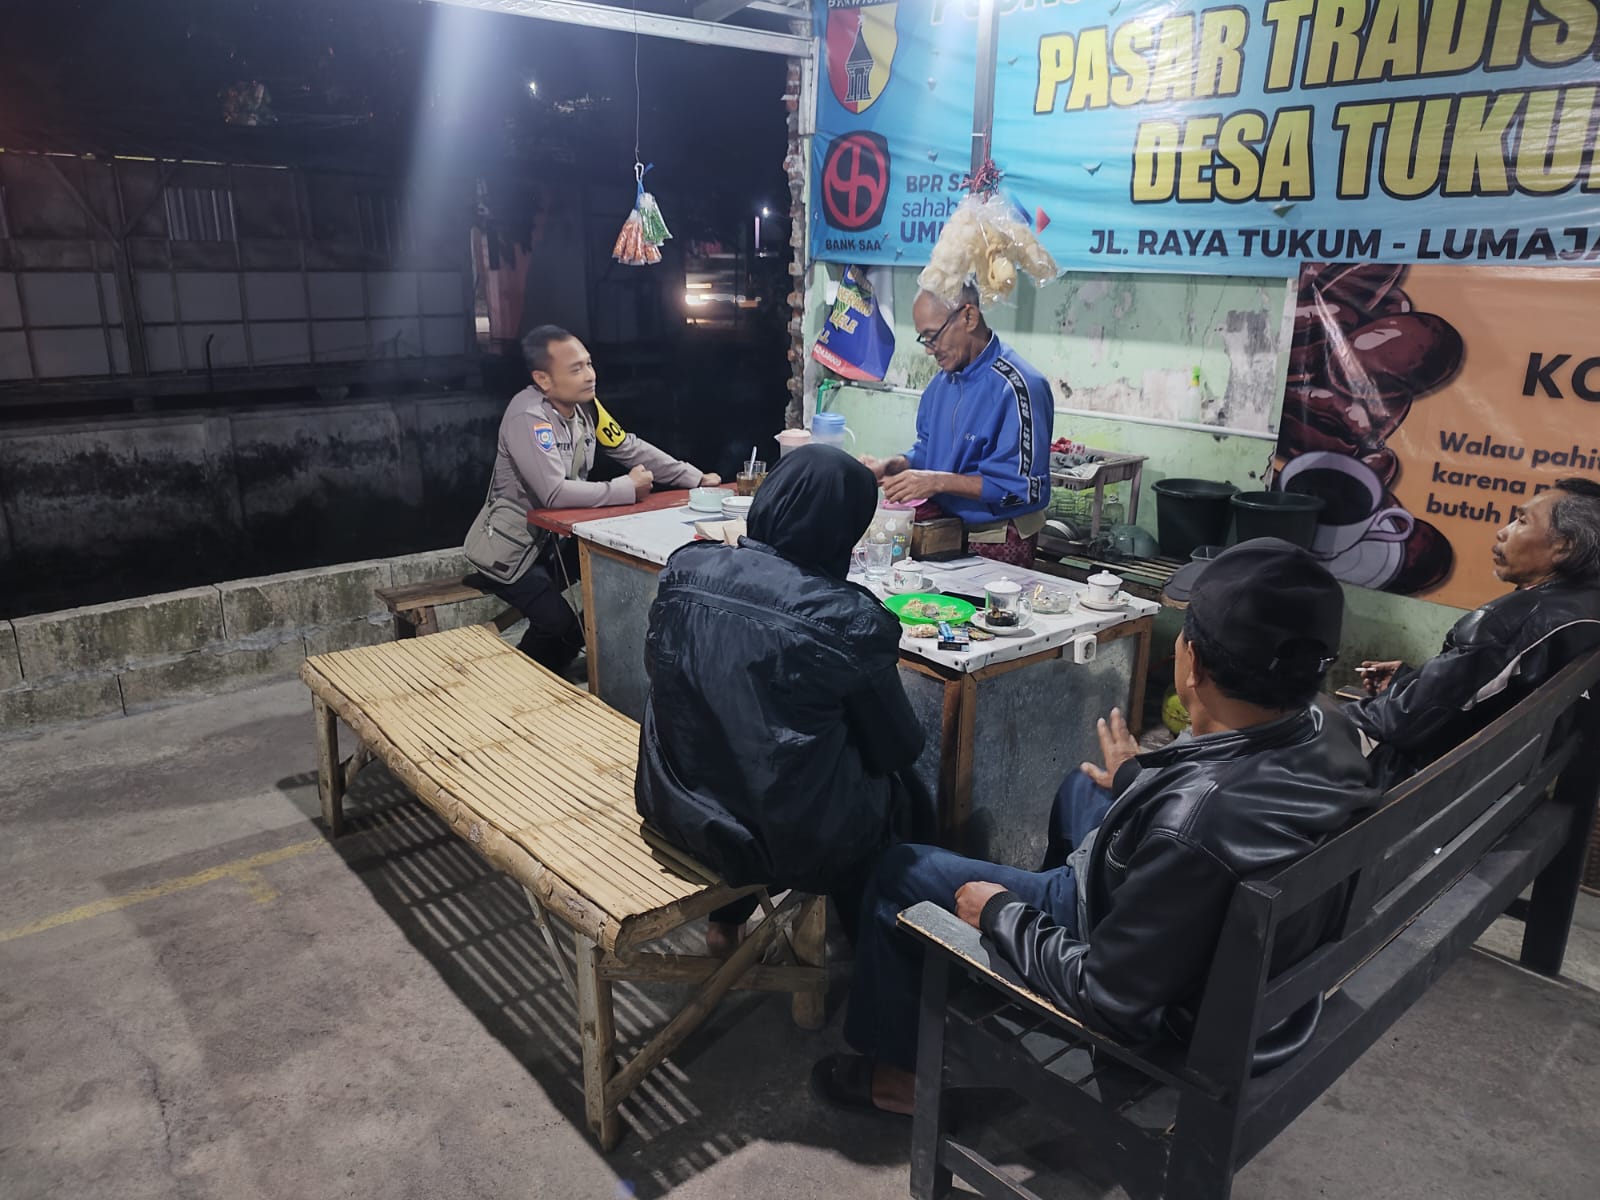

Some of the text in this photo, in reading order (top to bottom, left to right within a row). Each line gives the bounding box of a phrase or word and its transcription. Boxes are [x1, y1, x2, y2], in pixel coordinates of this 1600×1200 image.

[1034, 0, 1600, 115] PASAR TRADIS
[1130, 81, 1600, 203] DESA TUKU
[906, 174, 943, 193] BPR
[825, 239, 882, 251] BANK SAA
[1089, 229, 1128, 256] JL.
[1137, 230, 1229, 257] RAYA
[1238, 229, 1382, 258] TUKUM
[1440, 430, 1600, 471] Walau pahi
[1432, 462, 1526, 494] karena
[1426, 493, 1501, 524] butuh
